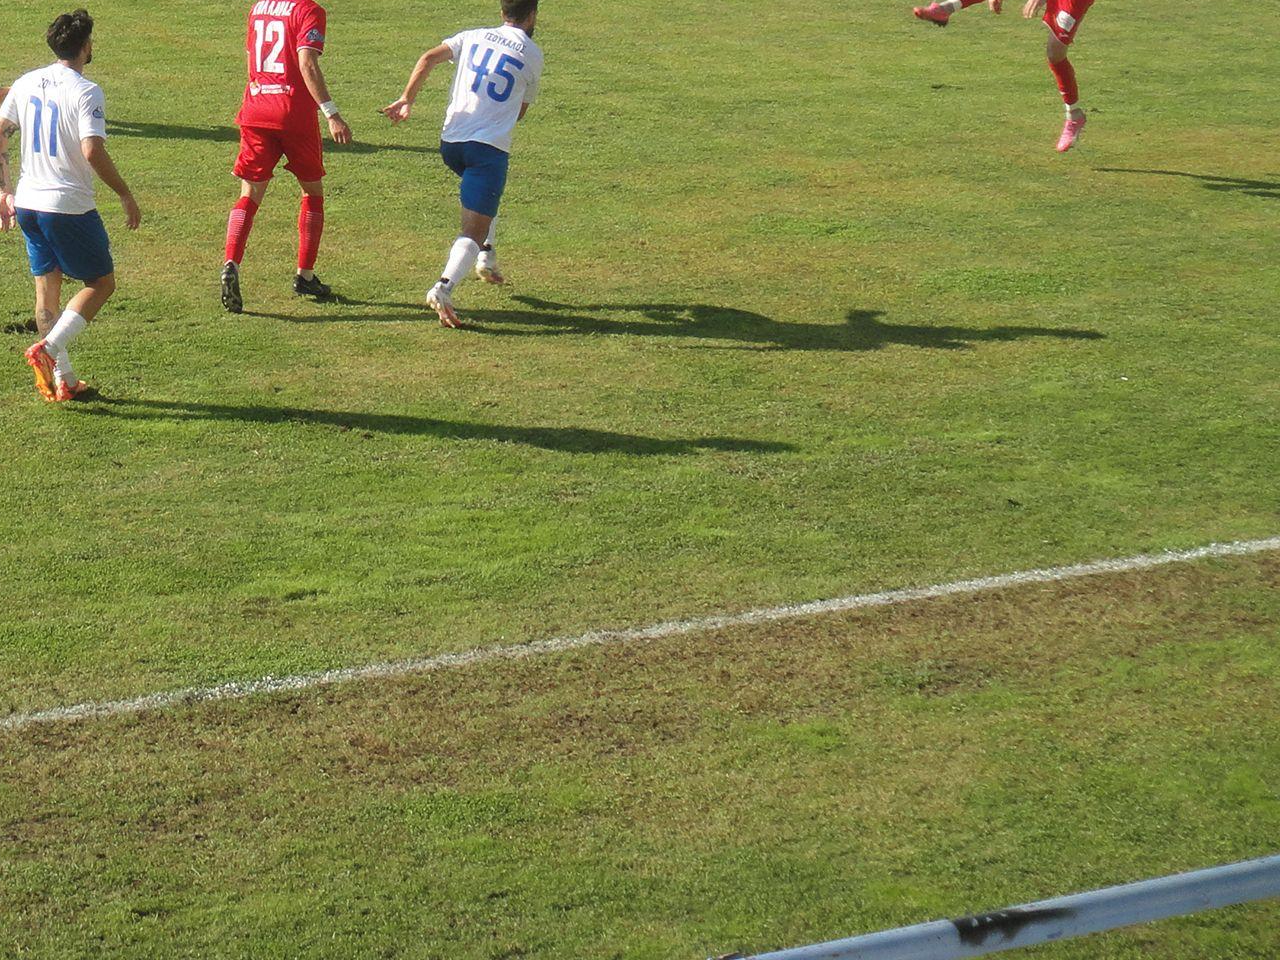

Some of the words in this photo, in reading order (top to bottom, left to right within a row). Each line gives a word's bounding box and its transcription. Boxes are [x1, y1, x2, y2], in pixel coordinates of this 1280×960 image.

[254, 20, 286, 75] 12
[468, 43, 525, 103] 45
[28, 95, 59, 158] 11
